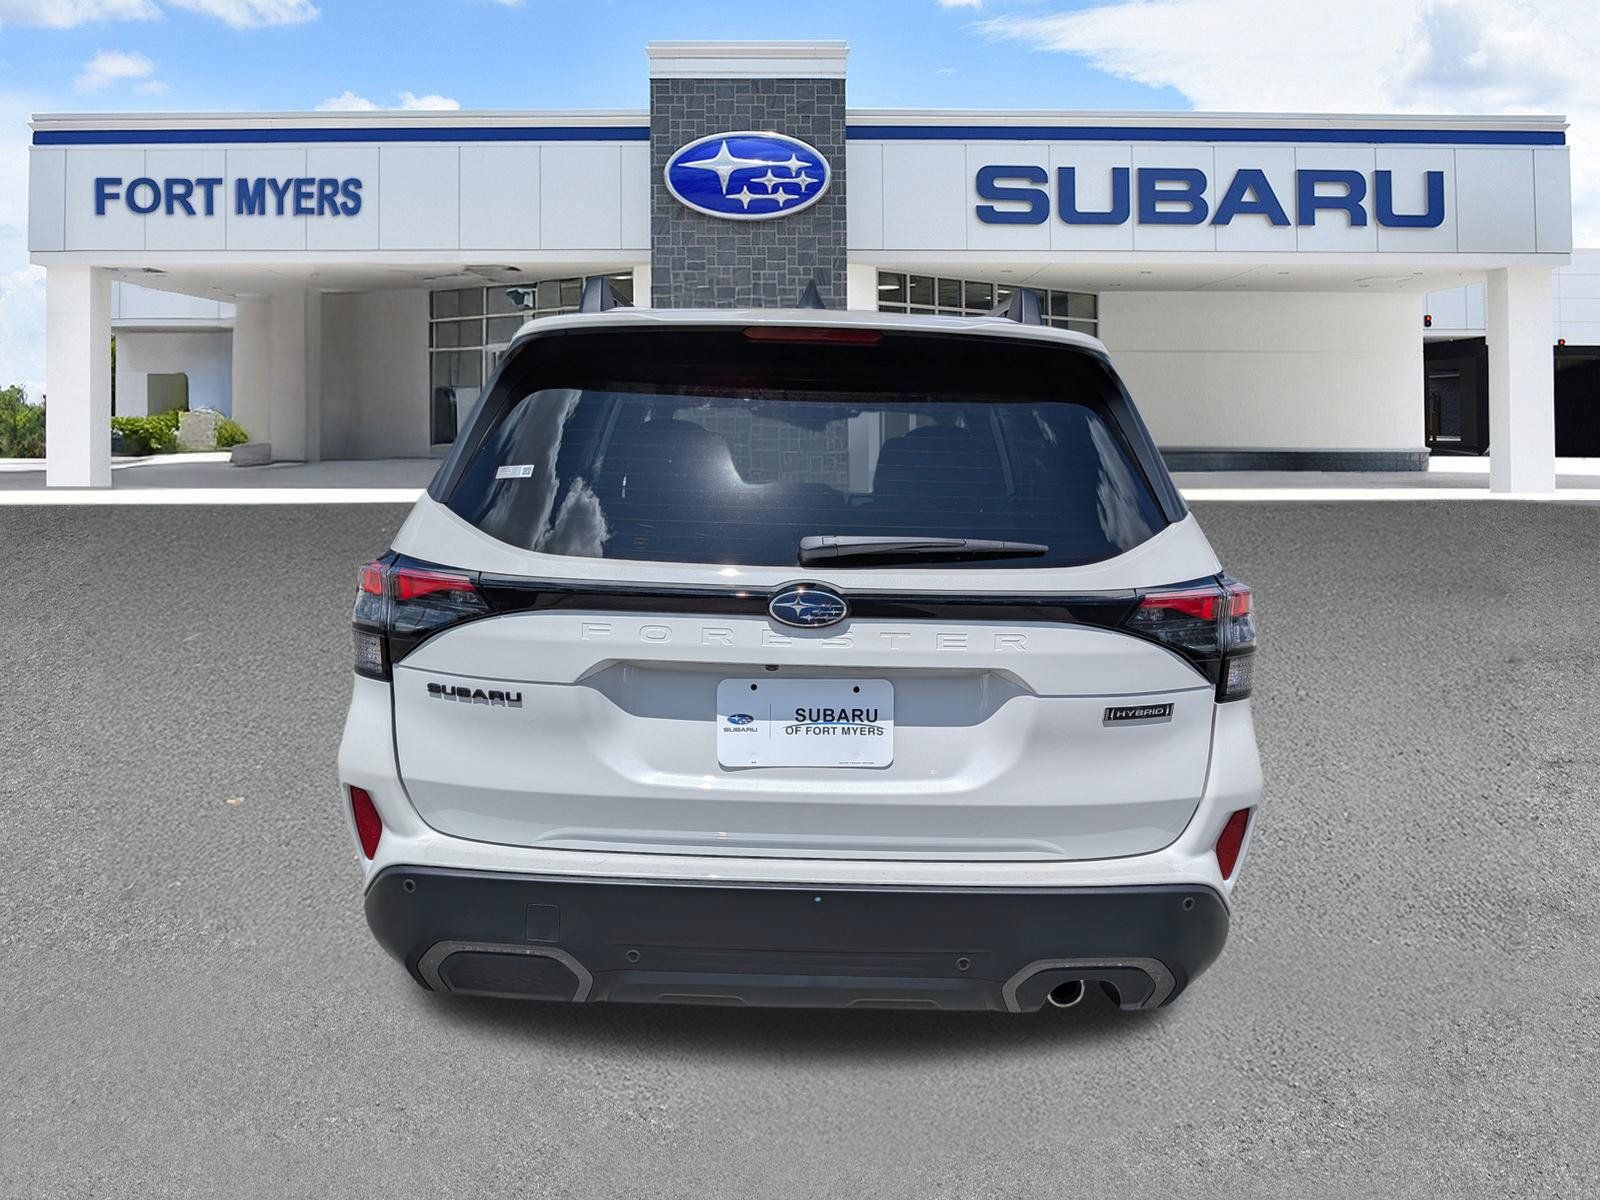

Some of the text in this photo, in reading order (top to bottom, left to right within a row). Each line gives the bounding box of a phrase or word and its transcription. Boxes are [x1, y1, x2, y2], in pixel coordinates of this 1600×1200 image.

[94, 177, 363, 216] FORT MYERS
[975, 164, 1445, 229] SUBARU
[579, 621, 1032, 653] FORESTER
[427, 682, 522, 703] SUBARU
[795, 708, 878, 723] SUBARU
[1116, 707, 1164, 718] HYBRID
[785, 726, 884, 736] OF FORT MYERS
